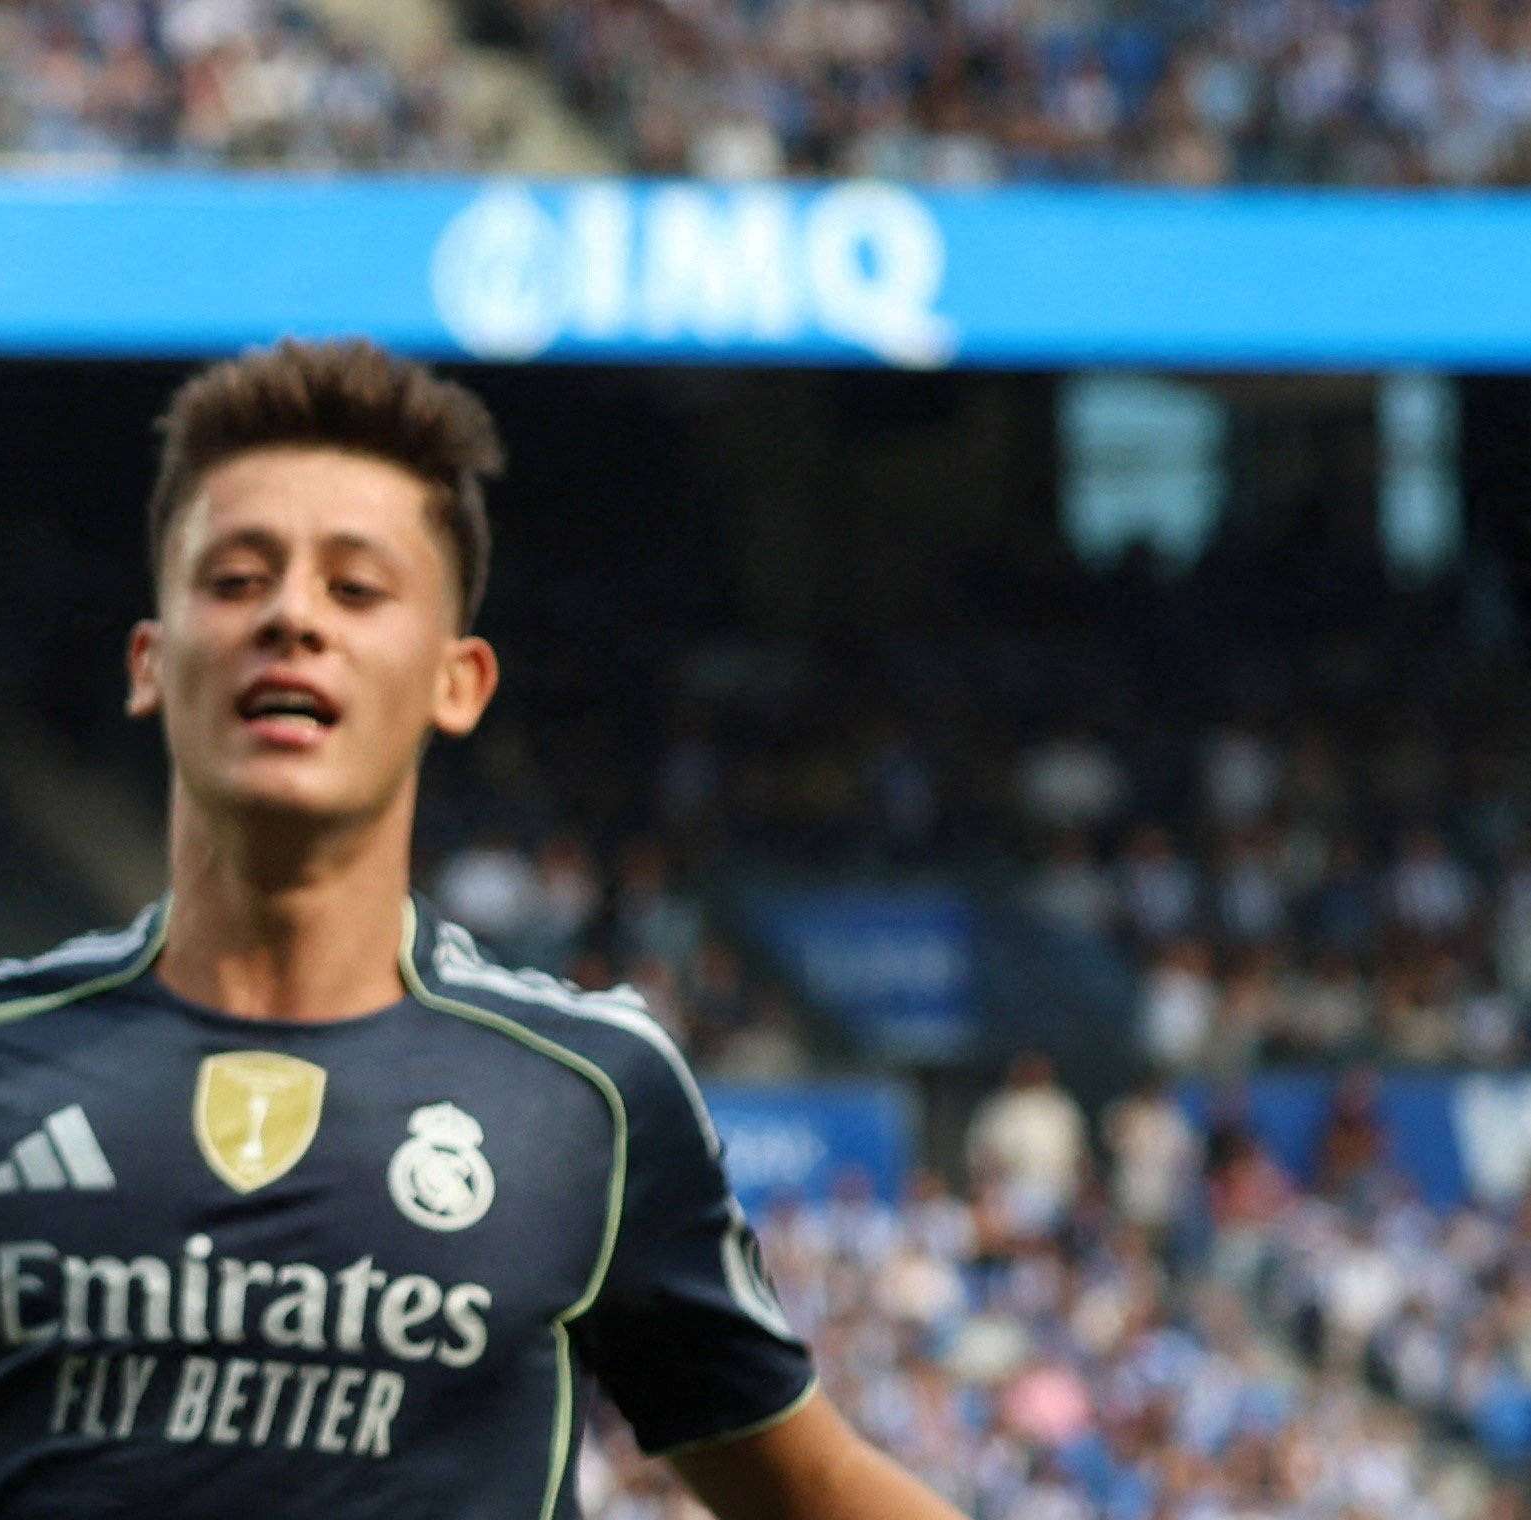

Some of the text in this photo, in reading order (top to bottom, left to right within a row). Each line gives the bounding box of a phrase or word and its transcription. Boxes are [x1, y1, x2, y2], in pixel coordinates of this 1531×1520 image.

[562, 178, 958, 370] IMQ
[50, 1354, 406, 1458] FLY BETTER
